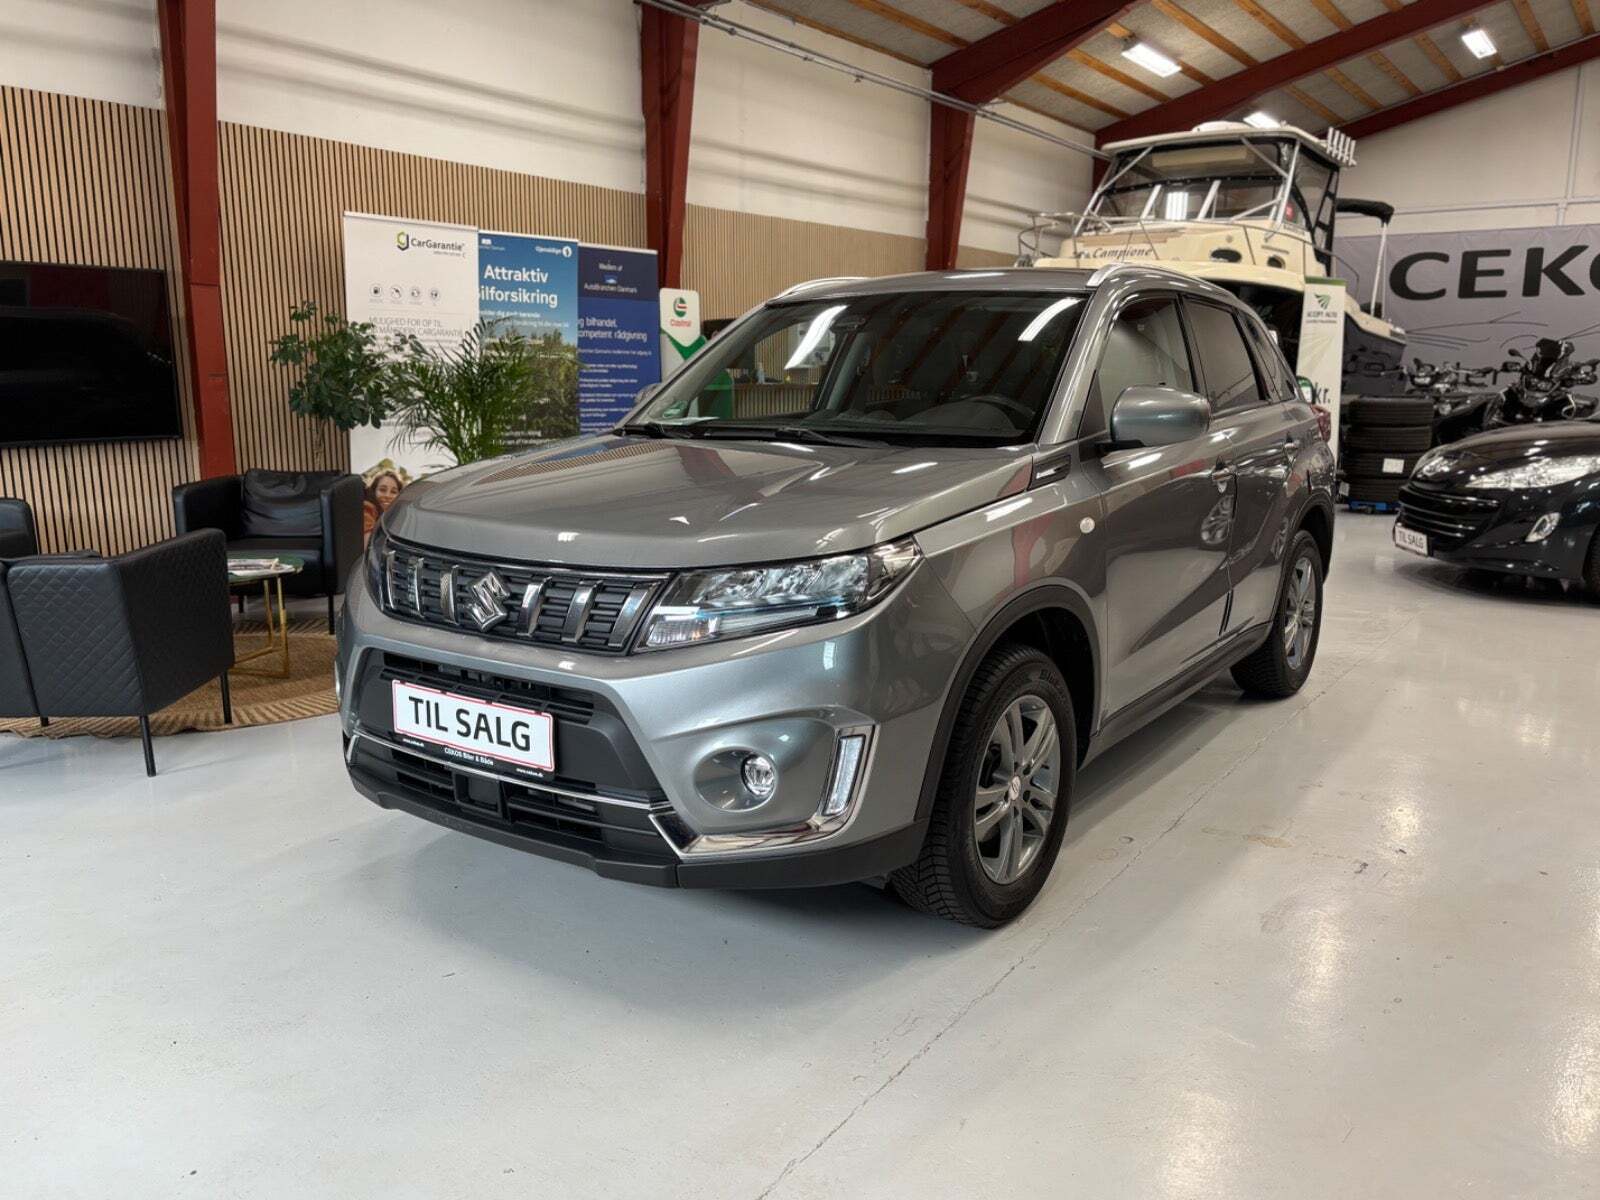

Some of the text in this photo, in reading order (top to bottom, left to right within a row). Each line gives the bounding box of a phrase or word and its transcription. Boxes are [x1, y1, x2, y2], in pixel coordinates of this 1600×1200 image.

[410, 237, 463, 251] CarGarantie
[1093, 247, 1152, 260] Campione
[484, 264, 549, 283] Attraktiv
[1389, 245, 1600, 300] CEK
[478, 285, 558, 308] ilforsikring
[578, 329, 612, 340] ompetent
[1407, 534, 1424, 549] SALG
[408, 695, 531, 752] TIL SALG
